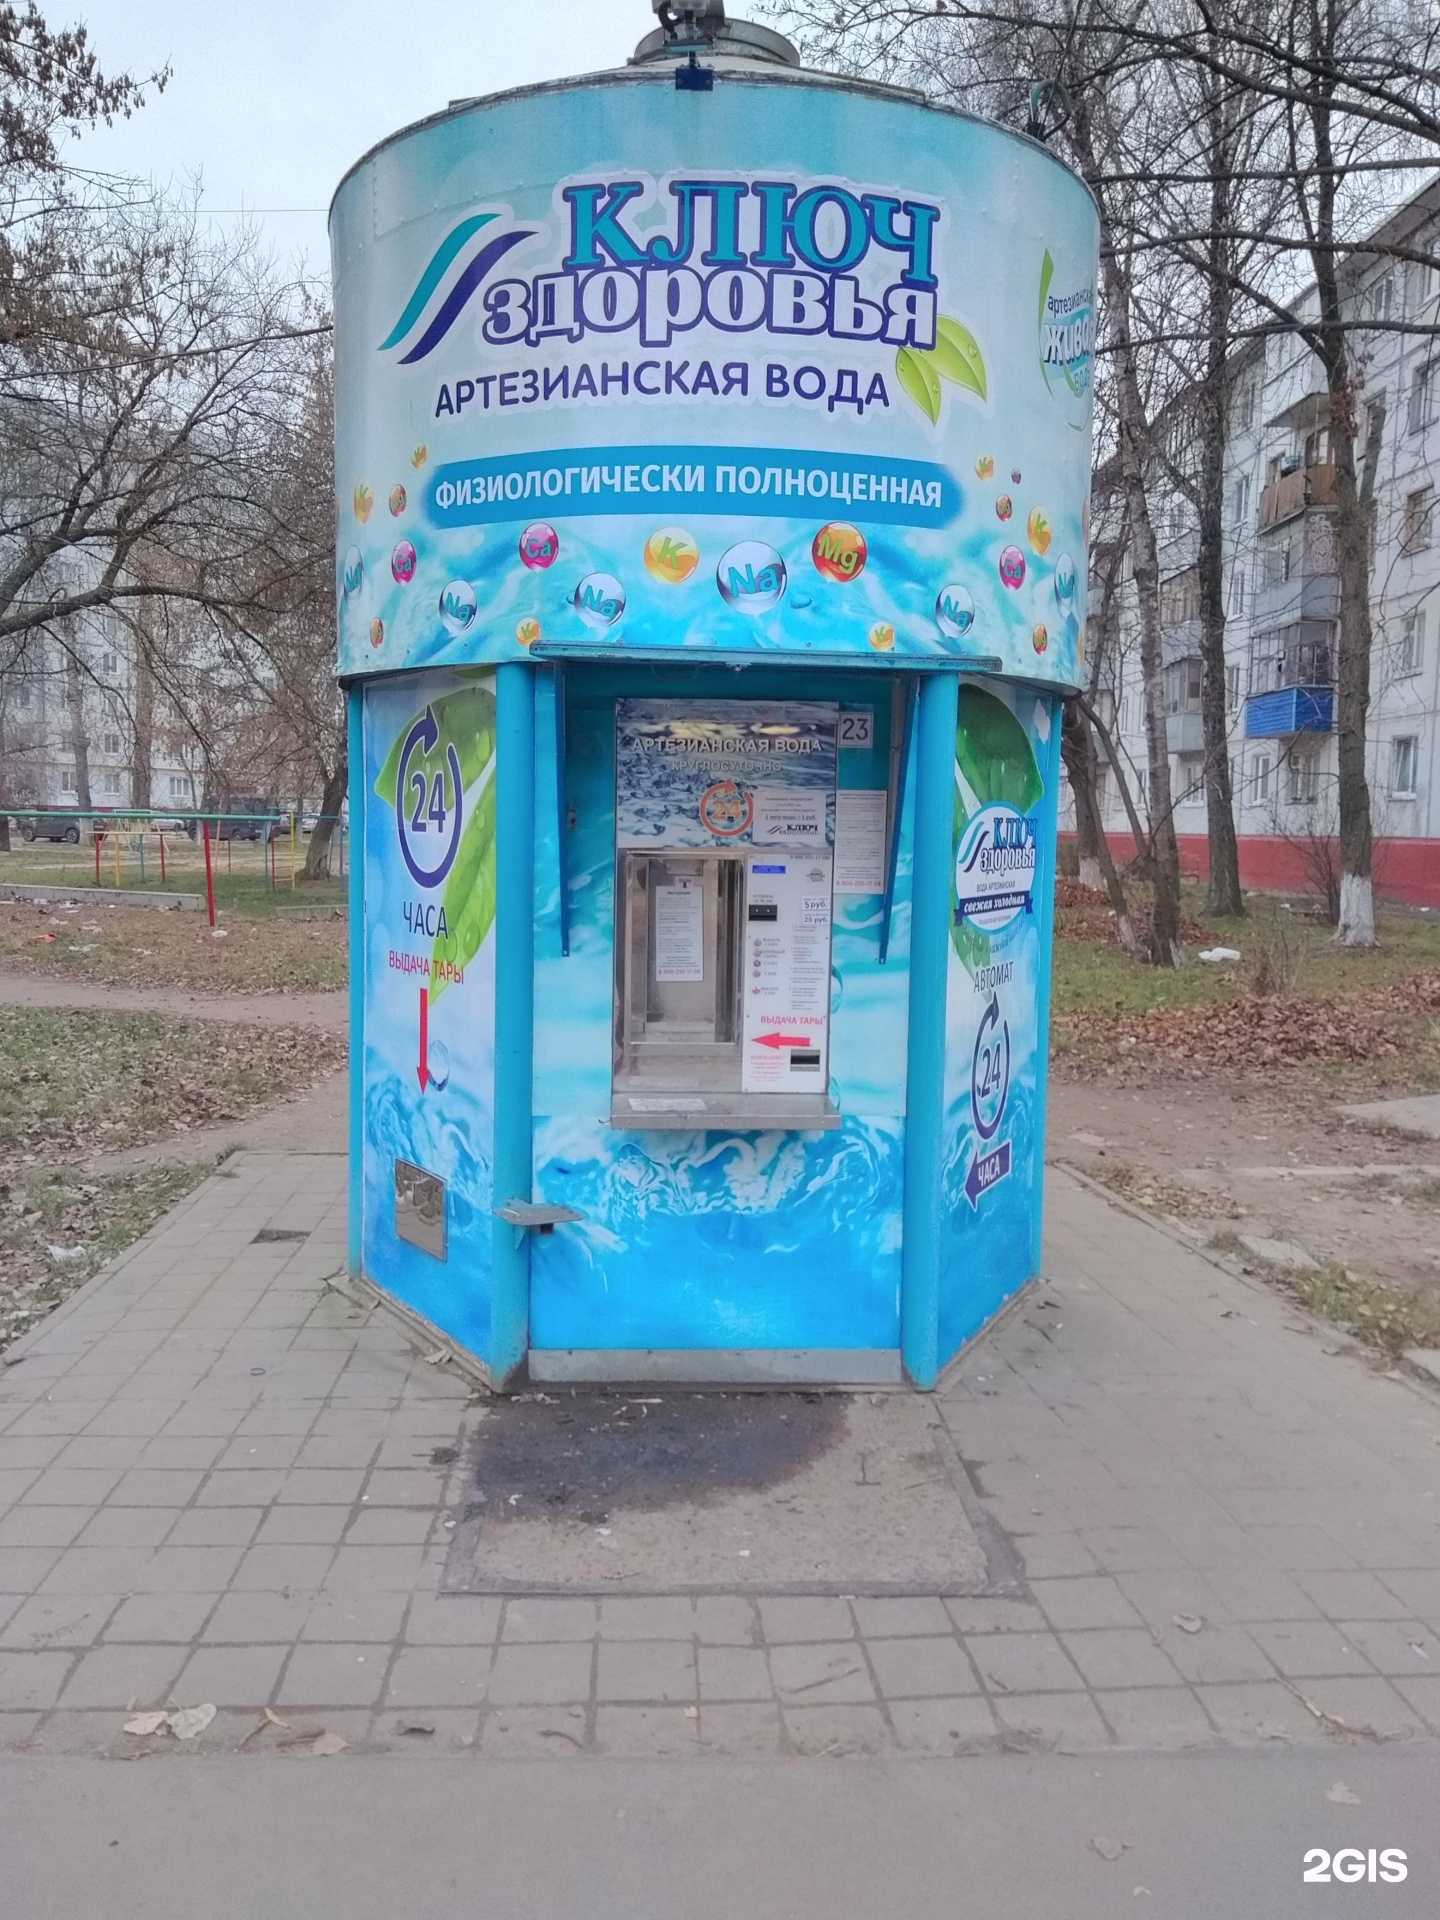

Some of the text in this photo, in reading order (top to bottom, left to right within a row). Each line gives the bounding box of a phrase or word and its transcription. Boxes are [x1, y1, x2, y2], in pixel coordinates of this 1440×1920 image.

[563, 180, 941, 289] КЛЮЧ
[435, 360, 889, 418] АРТЕЗИАНСКАЯ ВОДА
[435, 465, 704, 509] ФИЗИОЛОГИЧЕСКИ
[715, 465, 942, 508] ПОЛНОЦЕННАЯ
[526, 536, 552, 559] Ca
[657, 536, 687, 570] K
[817, 535, 859, 571] Mg
[728, 563, 785, 597] Na
[445, 591, 470, 622] Na
[580, 584, 616, 618] Na
[942, 595, 972, 628] Na
[632, 738, 824, 754] АРТЕЗИАНСКАЯ ВОДА
[842, 718, 869, 741] 23
[411, 772, 446, 833] 24
[712, 800, 741, 819] 24
[993, 817, 1037, 849] КЛЮЧ
[403, 901, 448, 939] ЧАСА
[389, 950, 464, 984] ВЫДАЧА ТАРЫ
[974, 961, 1014, 993] АВТОМАТ
[761, 1015, 823, 1025] ВЫДАЧА ТАРЫ
[981, 1044, 1001, 1098] 24
[978, 1155, 1001, 1186] ЧАСА
